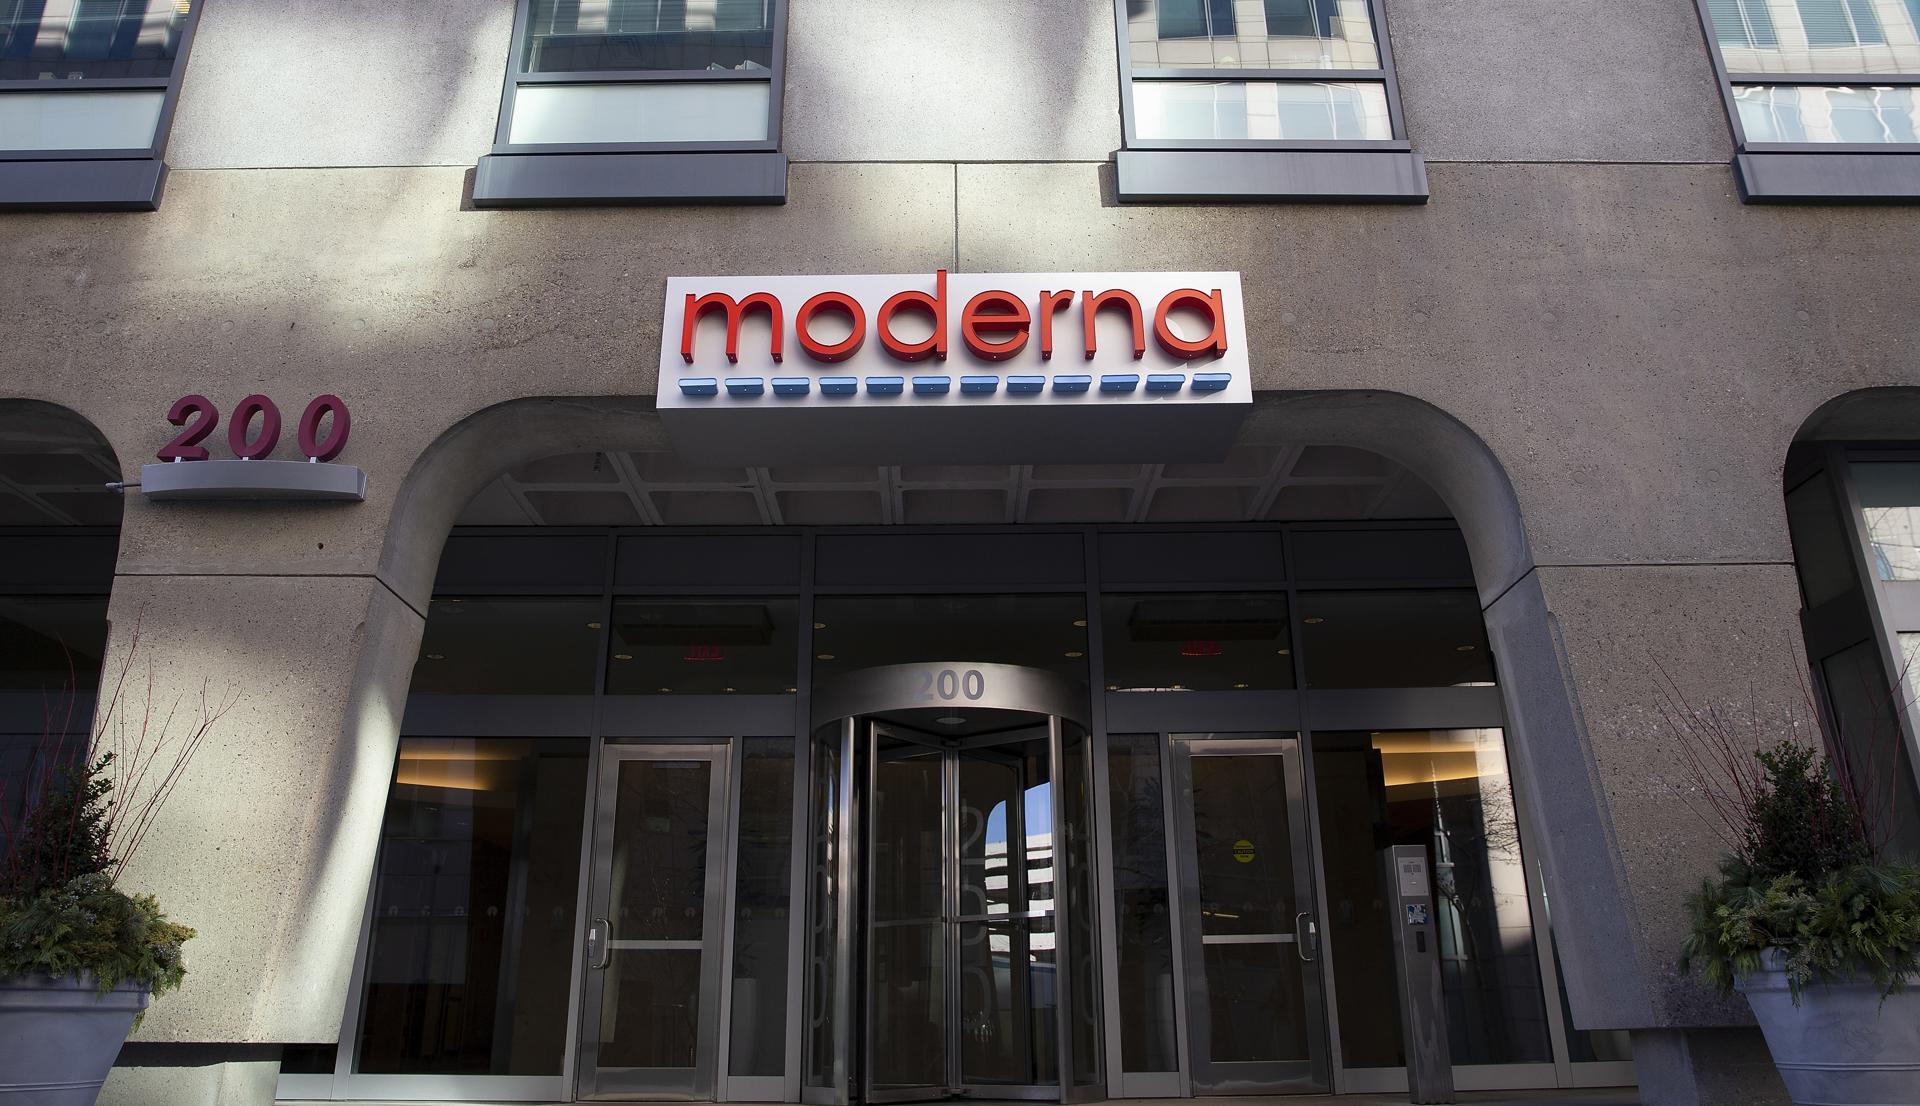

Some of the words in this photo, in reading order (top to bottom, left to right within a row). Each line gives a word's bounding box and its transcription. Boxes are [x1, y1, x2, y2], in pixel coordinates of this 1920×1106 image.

[680, 269, 1228, 363] moderna
[157, 394, 351, 462] 200
[914, 669, 985, 701] 200
